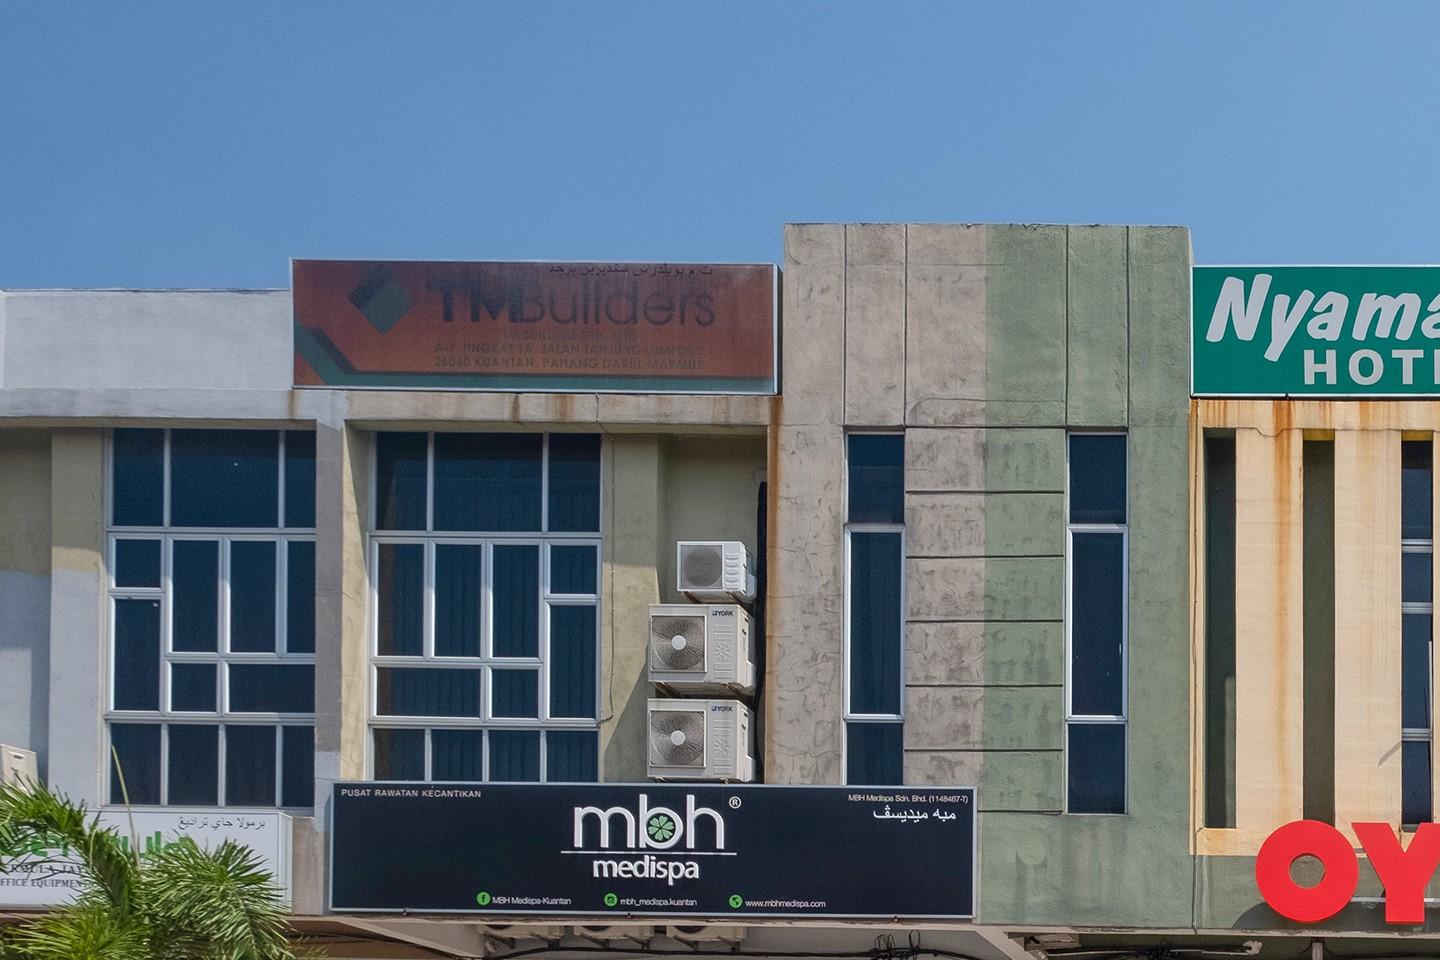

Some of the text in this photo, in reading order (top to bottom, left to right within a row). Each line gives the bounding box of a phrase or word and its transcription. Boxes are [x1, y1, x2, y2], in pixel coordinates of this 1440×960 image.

[341, 788, 482, 798] PUSAT RAWATAN KECANTIKAN
[573, 794, 725, 850] mbh
[593, 855, 700, 886] medispa
[492, 896, 511, 905] MBH
[745, 900, 826, 909] www.mbhmedispa.com
